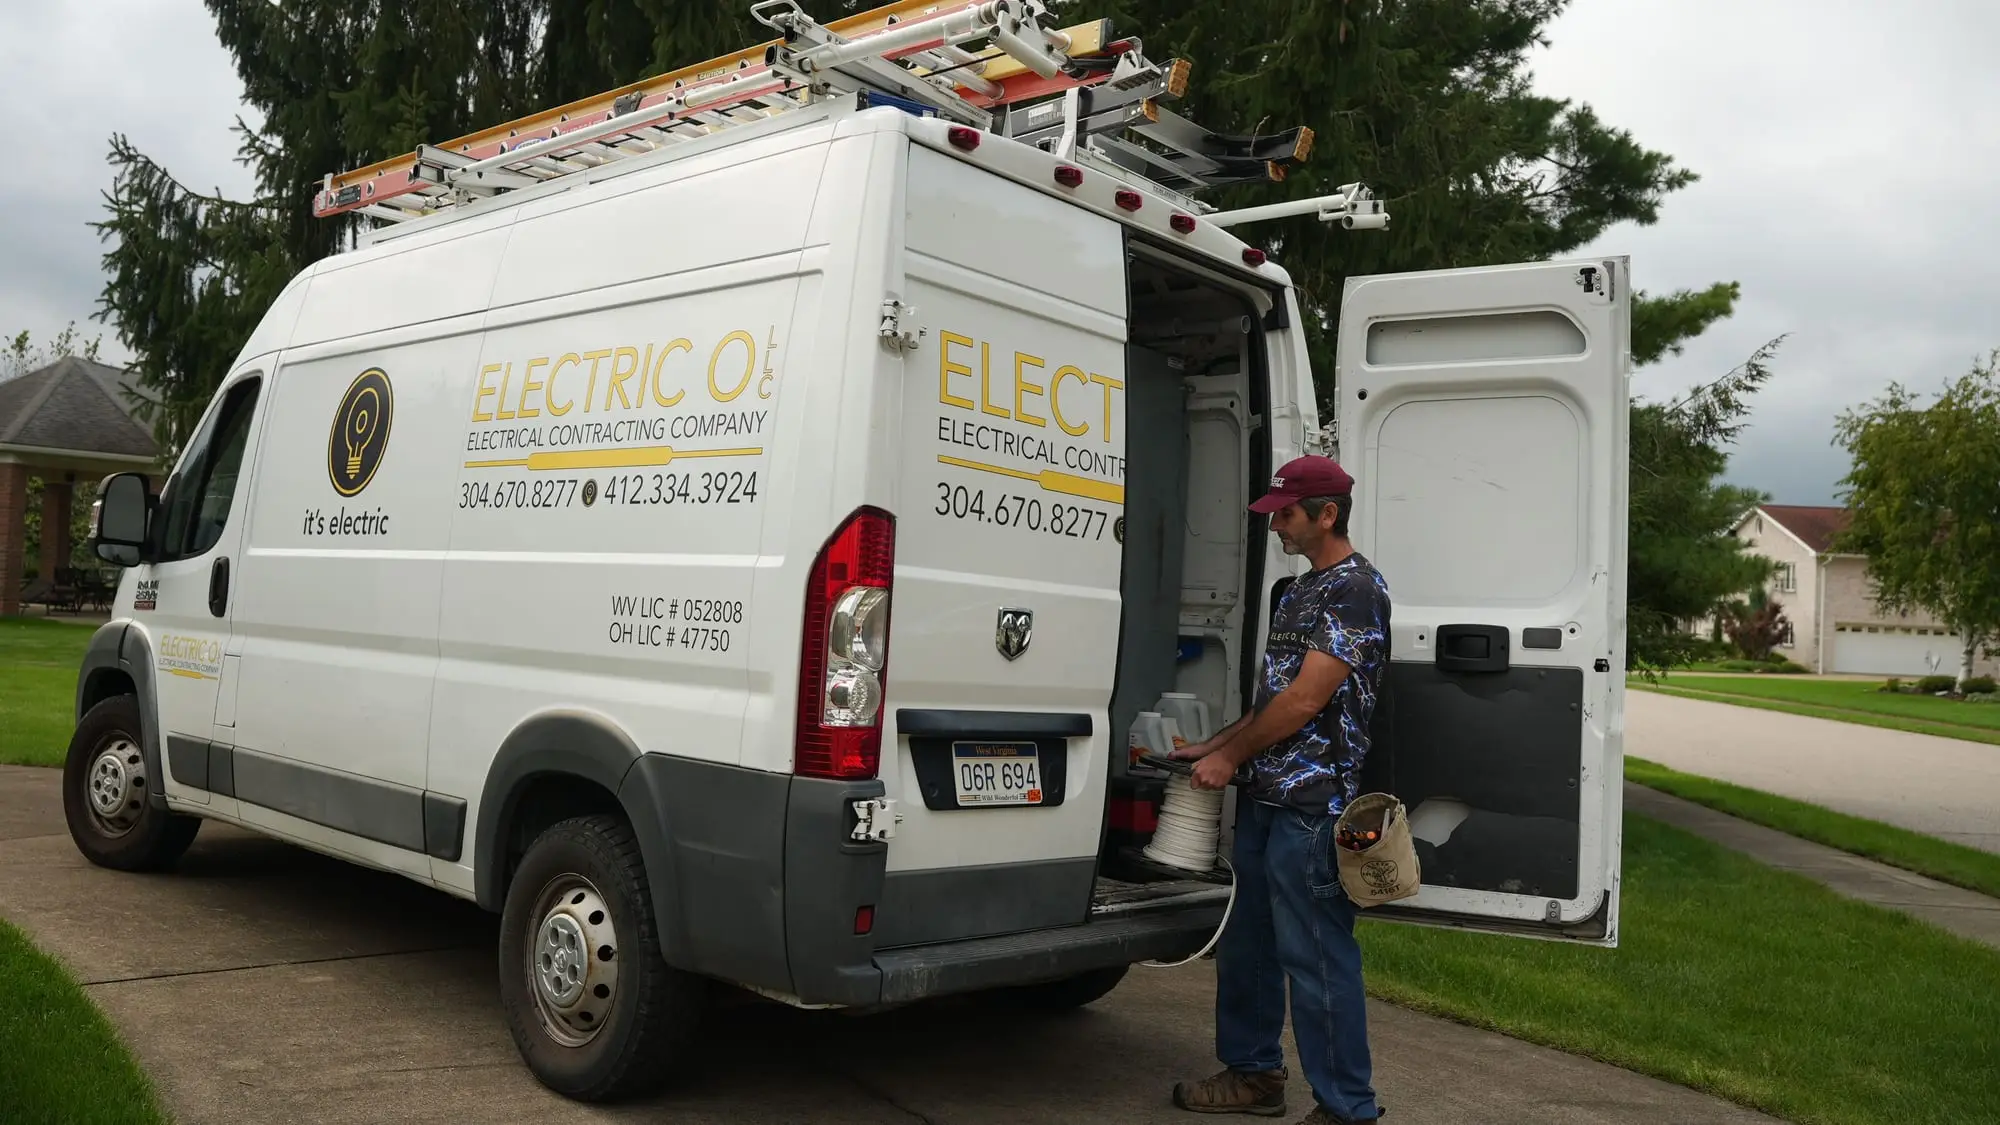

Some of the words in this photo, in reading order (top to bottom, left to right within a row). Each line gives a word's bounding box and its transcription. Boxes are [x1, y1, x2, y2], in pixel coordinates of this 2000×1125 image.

[471, 338, 693, 422] ELECTRIC
[707, 330, 755, 402] O
[939, 330, 1123, 443] ELECT
[467, 427, 544, 451] ELECTRICAL
[549, 417, 665, 446] CONTRACTING
[670, 410, 768, 439] COMPANY
[938, 416, 1059, 465] ELECTRICAL
[459, 479, 578, 509] 304.670.8277
[604, 471, 758, 505] 412.334.3924
[303, 508, 325, 535] it's
[329, 506, 389, 535] electric
[935, 482, 1108, 541] 304.670.8277
[612, 595, 637, 616] WV
[641, 597, 664, 619] LIC
[669, 598, 678, 619] #
[683, 599, 743, 623] 052808
[160, 634, 208, 662] ELECTRIC
[609, 622, 633, 644] OH
[638, 624, 662, 646] LIC
[666, 626, 676, 647] #
[680, 627, 730, 652] 47750
[976, 745, 991, 755] West
[993, 745, 1017, 756] Virginia
[1002, 763, 1036, 790] 694
